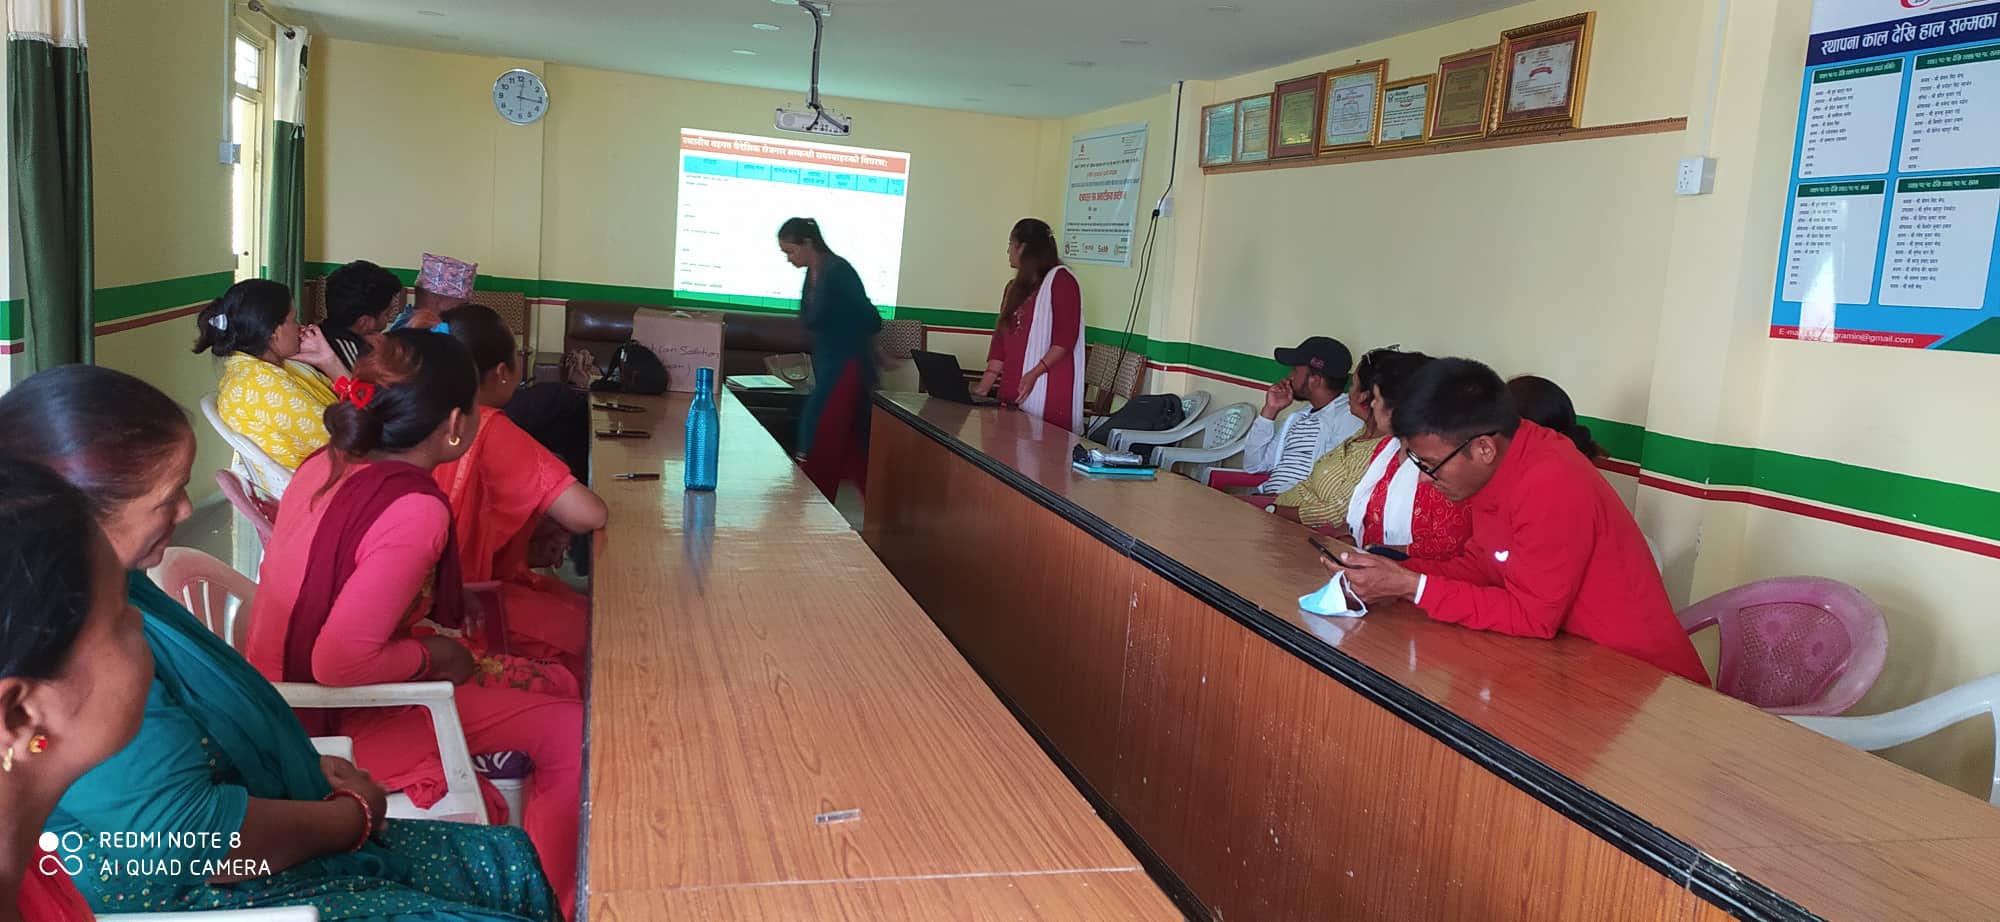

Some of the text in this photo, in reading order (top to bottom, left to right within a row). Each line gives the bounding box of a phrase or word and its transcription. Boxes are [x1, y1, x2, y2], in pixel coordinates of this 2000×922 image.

[1821, 12, 1999, 55] स्थापना काल देखि हाल सम्मका
